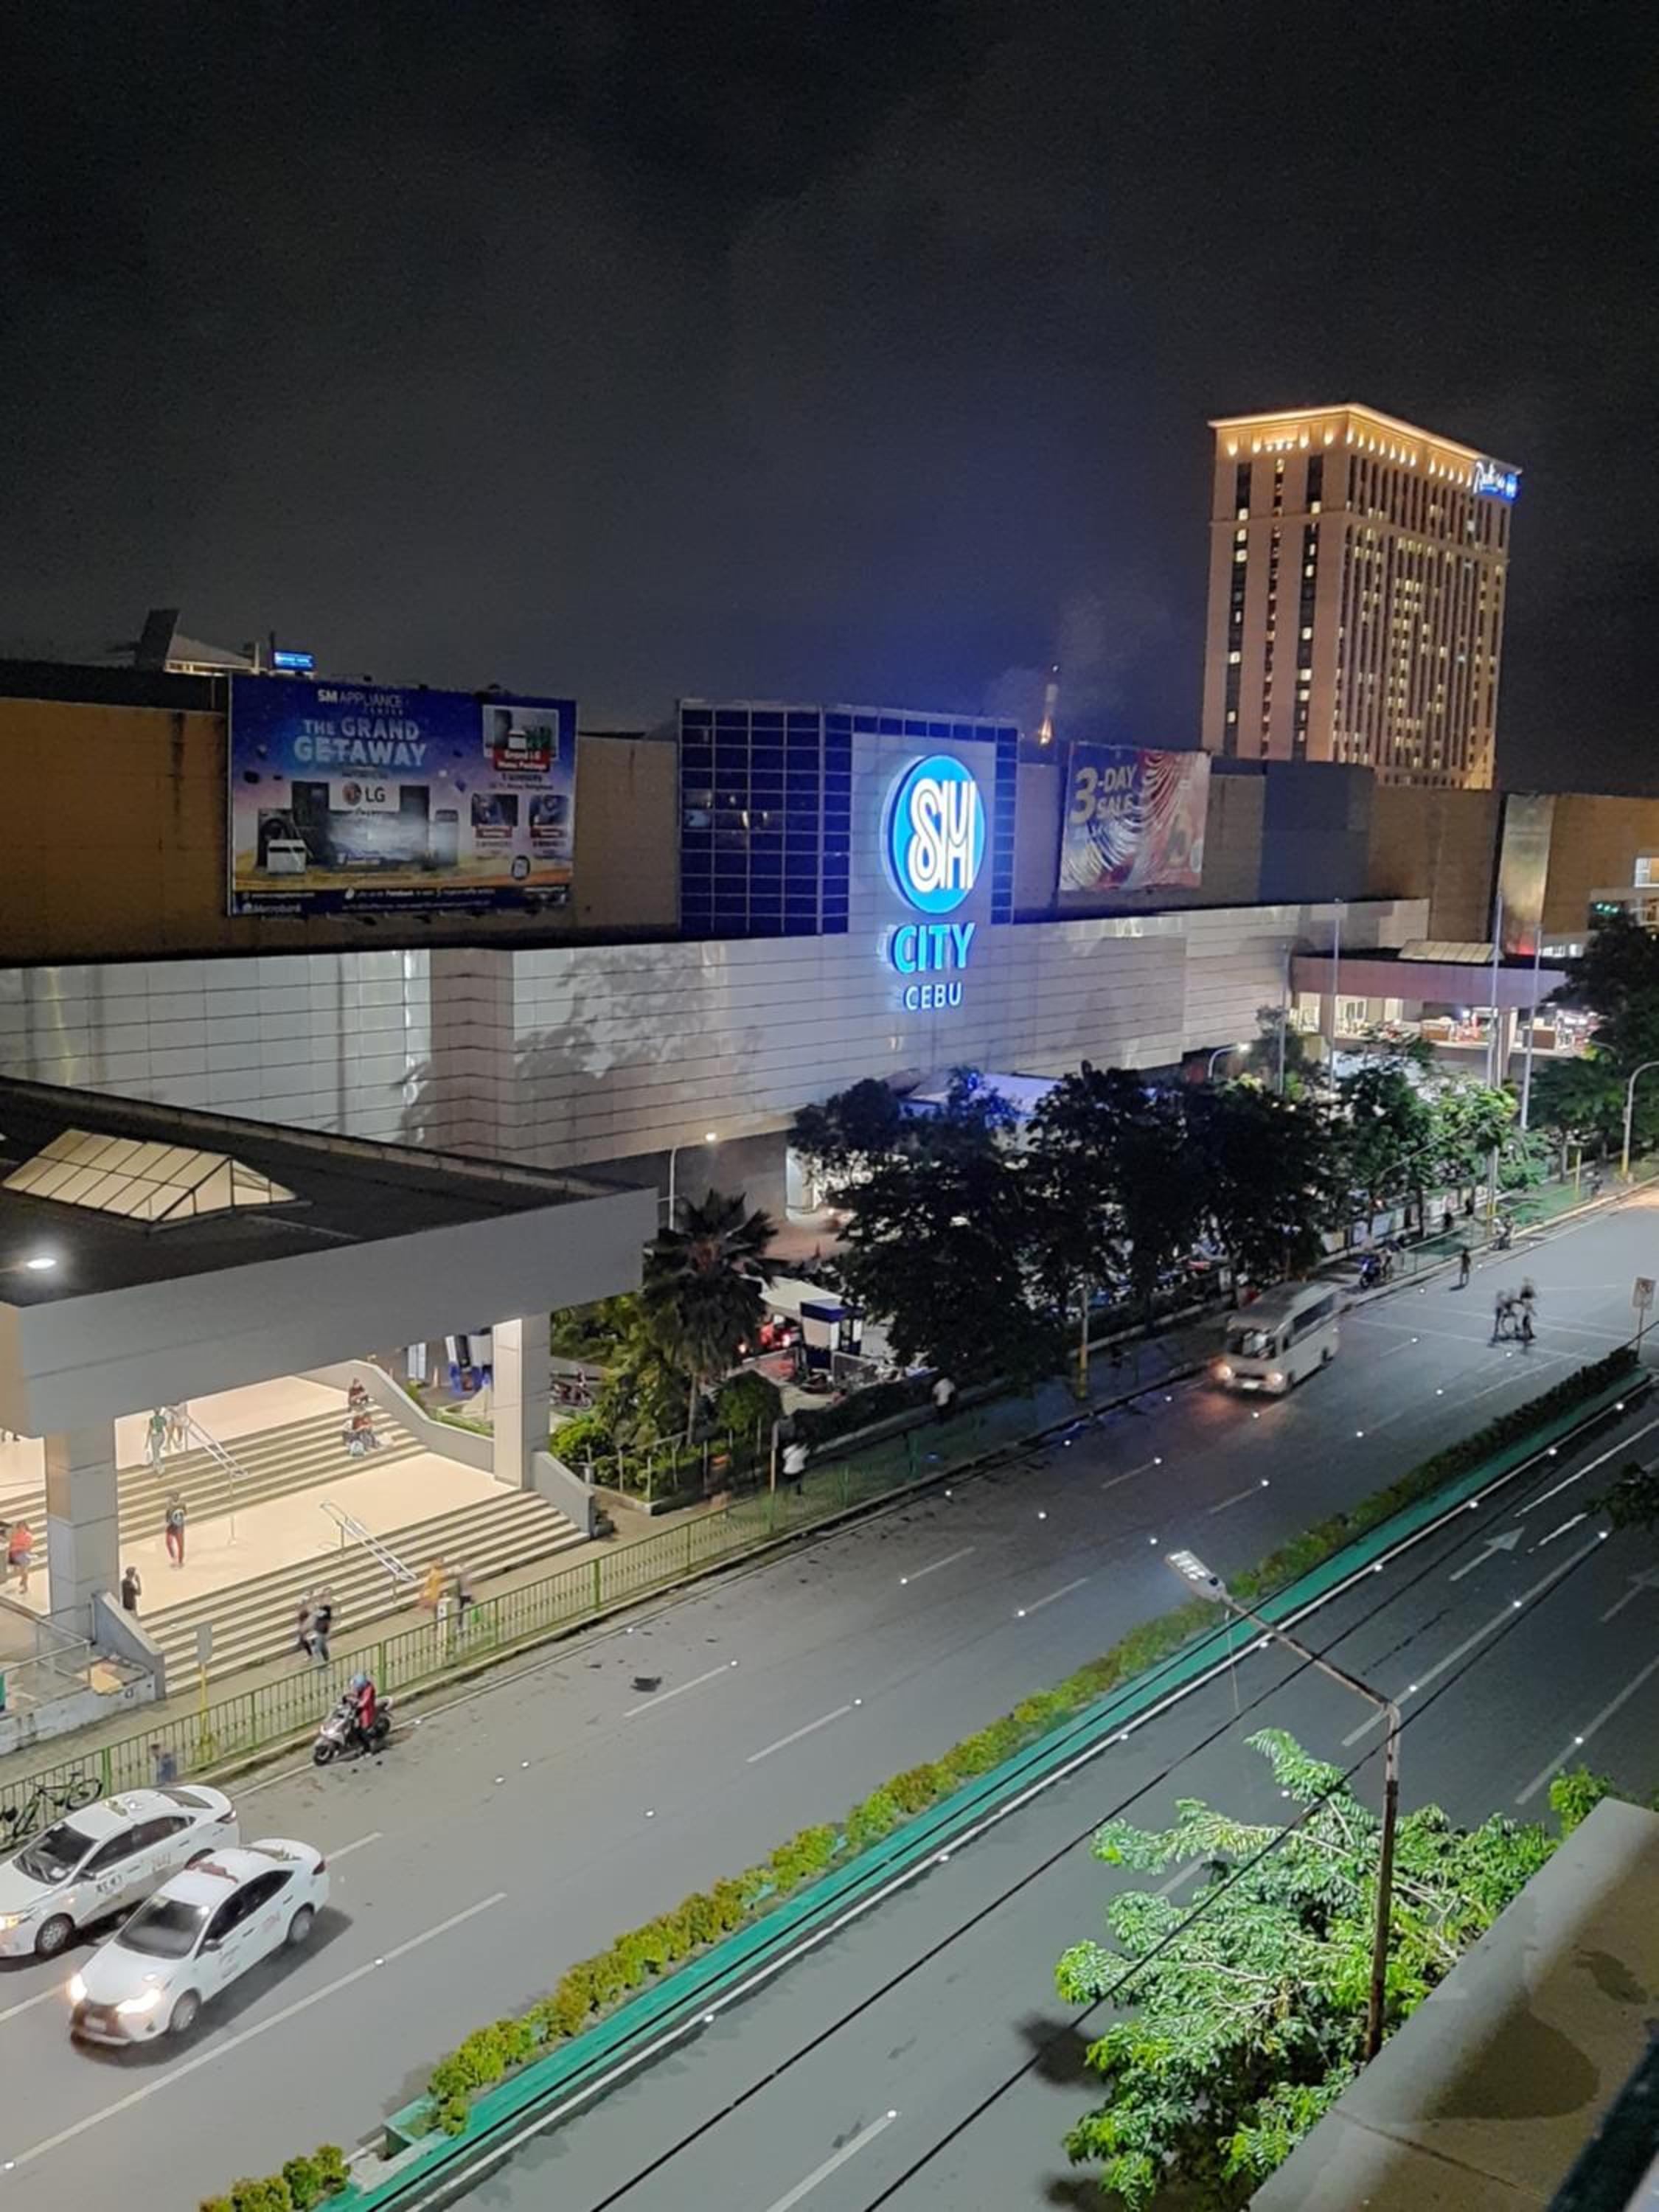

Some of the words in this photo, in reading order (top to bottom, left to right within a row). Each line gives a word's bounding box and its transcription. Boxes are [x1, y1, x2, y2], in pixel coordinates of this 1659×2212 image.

[317, 689, 338, 703] SM
[303, 719, 335, 735] THE
[341, 717, 420, 741] GRAND
[293, 735, 426, 766] GETAWAY
[364, 786, 386, 803] LG
[908, 777, 976, 893] SM
[891, 922, 976, 974] CITY
[904, 981, 962, 1011] CEBU
